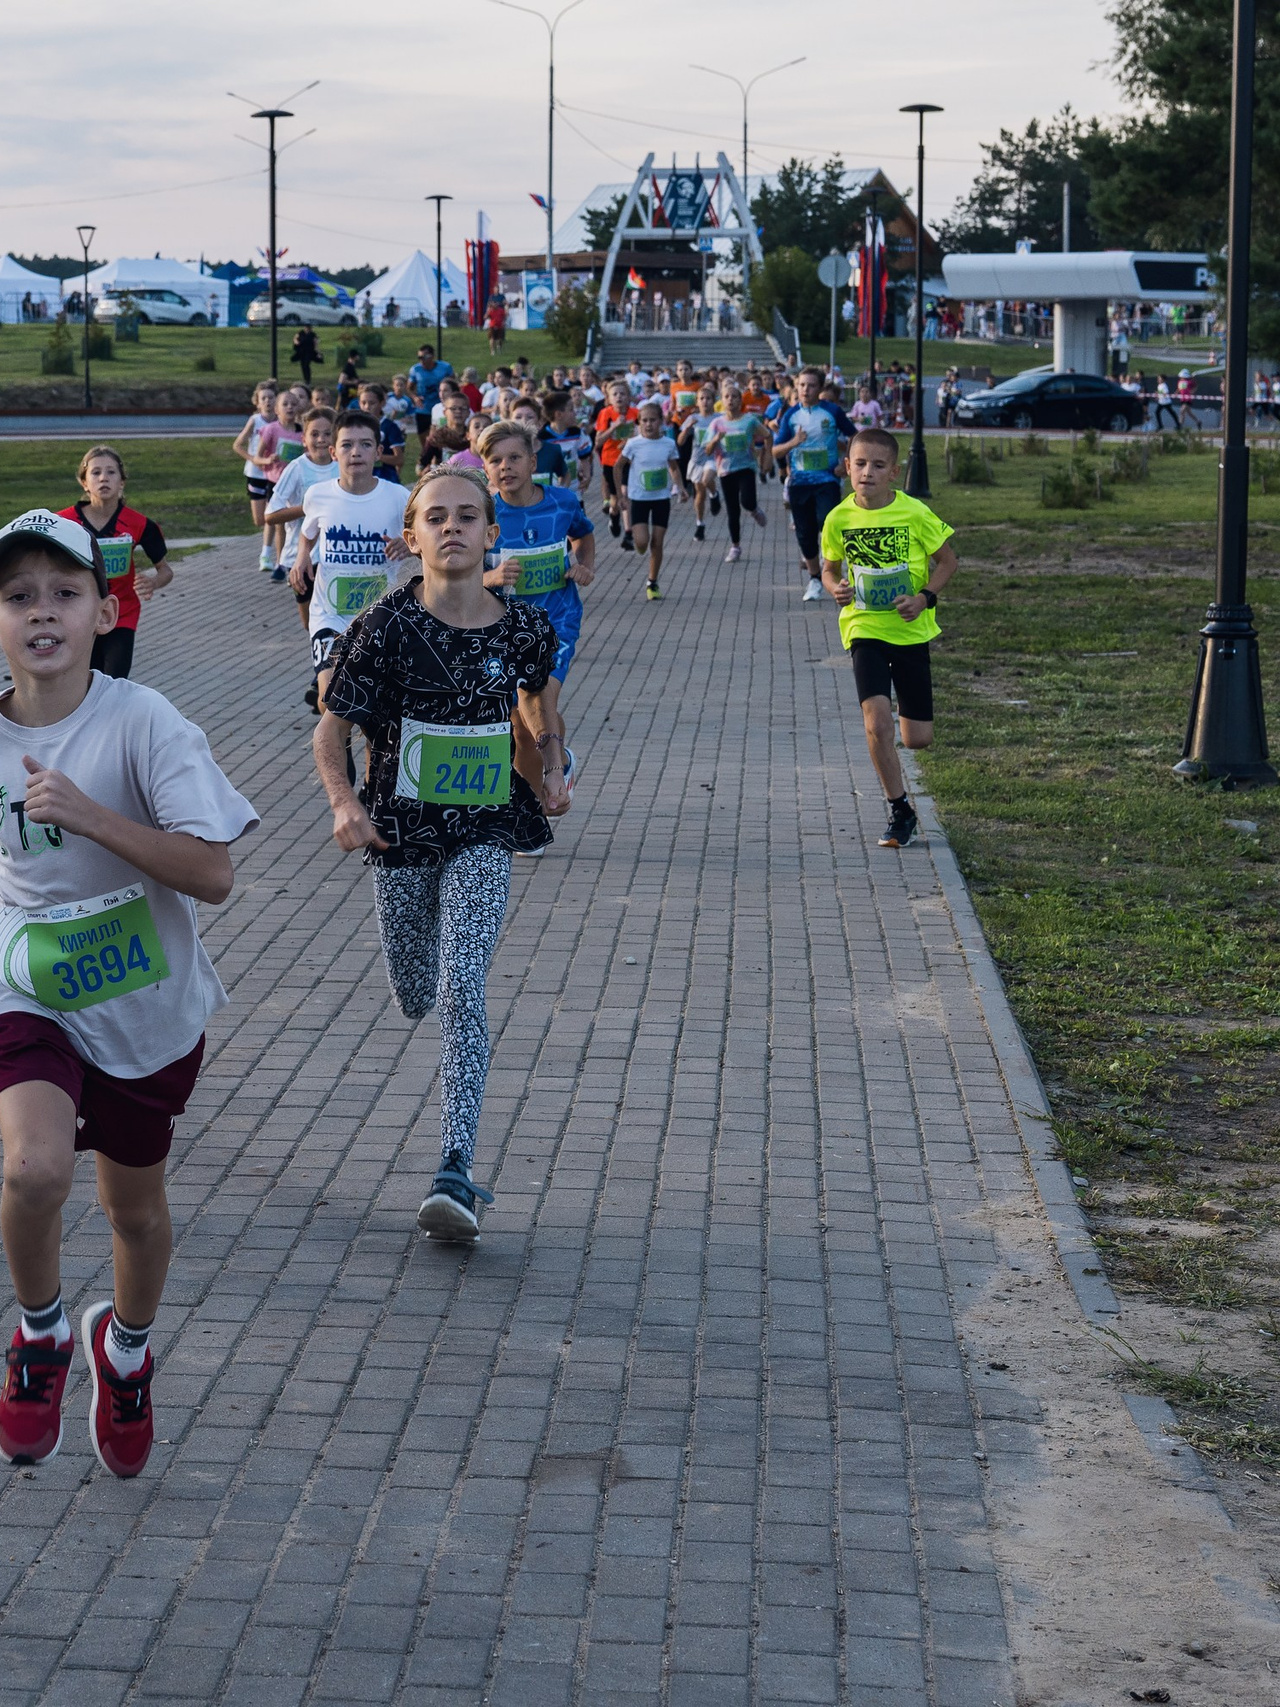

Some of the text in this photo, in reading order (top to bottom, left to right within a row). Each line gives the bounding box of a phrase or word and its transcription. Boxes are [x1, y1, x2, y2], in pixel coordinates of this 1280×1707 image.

[326, 540, 387, 552] КАЛУГА
[525, 565, 561, 589] 2388
[451, 746, 489, 759] АЛИНА
[434, 763, 502, 795] 2447
[57, 919, 123, 954] КИРИЛЛ
[52, 934, 151, 1000] 3694
